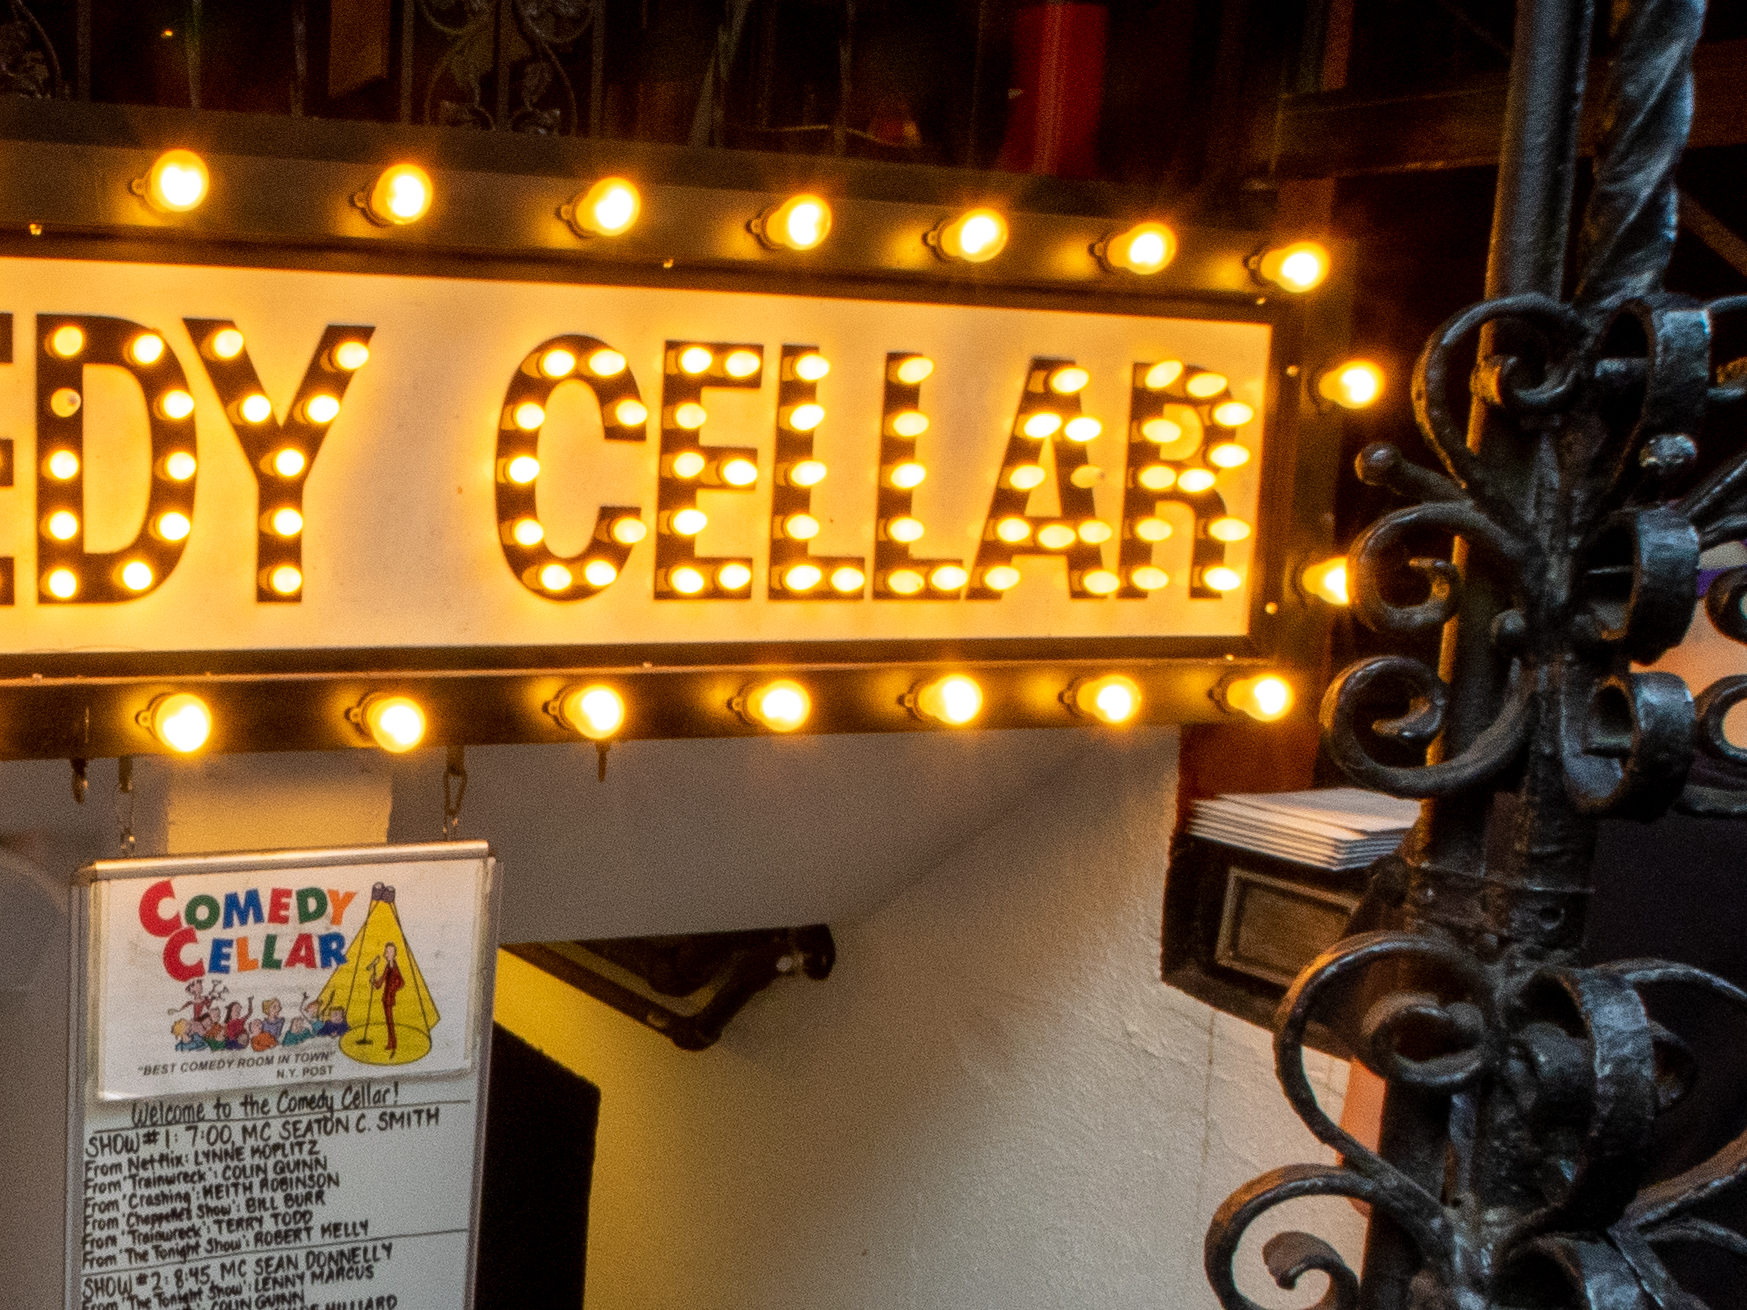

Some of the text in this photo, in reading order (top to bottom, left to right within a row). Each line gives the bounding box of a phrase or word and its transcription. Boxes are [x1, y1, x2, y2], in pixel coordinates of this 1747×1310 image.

[495, 333, 1250, 601] CELLAR
[138, 879, 358, 938] COMEDY
[162, 926, 348, 982] CELLAR
[180, 1059, 235, 1073] COMEDY
[237, 1055, 275, 1069] ROOM
[277, 1054, 291, 1065] IN
[301, 1065, 334, 1078] POST
[131, 1079, 399, 1129] Welcome to the Comedy Cellar!
[85, 1132, 139, 1158] SHOW
[240, 1121, 271, 1144] MC
[279, 1115, 350, 1140] SEATON
[355, 1112, 372, 1133] C.
[376, 1106, 439, 1131] SMITH
[84, 1159, 122, 1179] From
[194, 1145, 244, 1166] LYNNE
[84, 1177, 121, 1195] From
[221, 1162, 267, 1181] COLIN
[273, 1155, 327, 1175] QUINN
[83, 1196, 120, 1215] From
[202, 1180, 253, 1200] KEITH
[258, 1171, 340, 1192] ROBINSON
[83, 1214, 119, 1233] From
[245, 1196, 279, 1213] BILL
[283, 1188, 326, 1208] BURR
[82, 1209, 313, 1251] From TERRY TODD
[82, 1249, 117, 1268] From
[151, 1239, 200, 1267] Tonight
[253, 1225, 313, 1247] ROBERT
[319, 1217, 369, 1239] KELLY
[82, 1275, 132, 1300] SHOW
[219, 1258, 246, 1280] MC
[254, 1254, 299, 1276] SEAN
[305, 1241, 392, 1270] DONNELLY
[254, 1271, 305, 1292] LENNY
[310, 1262, 374, 1284] MARCUS
[254, 1289, 304, 1310] QUINN
